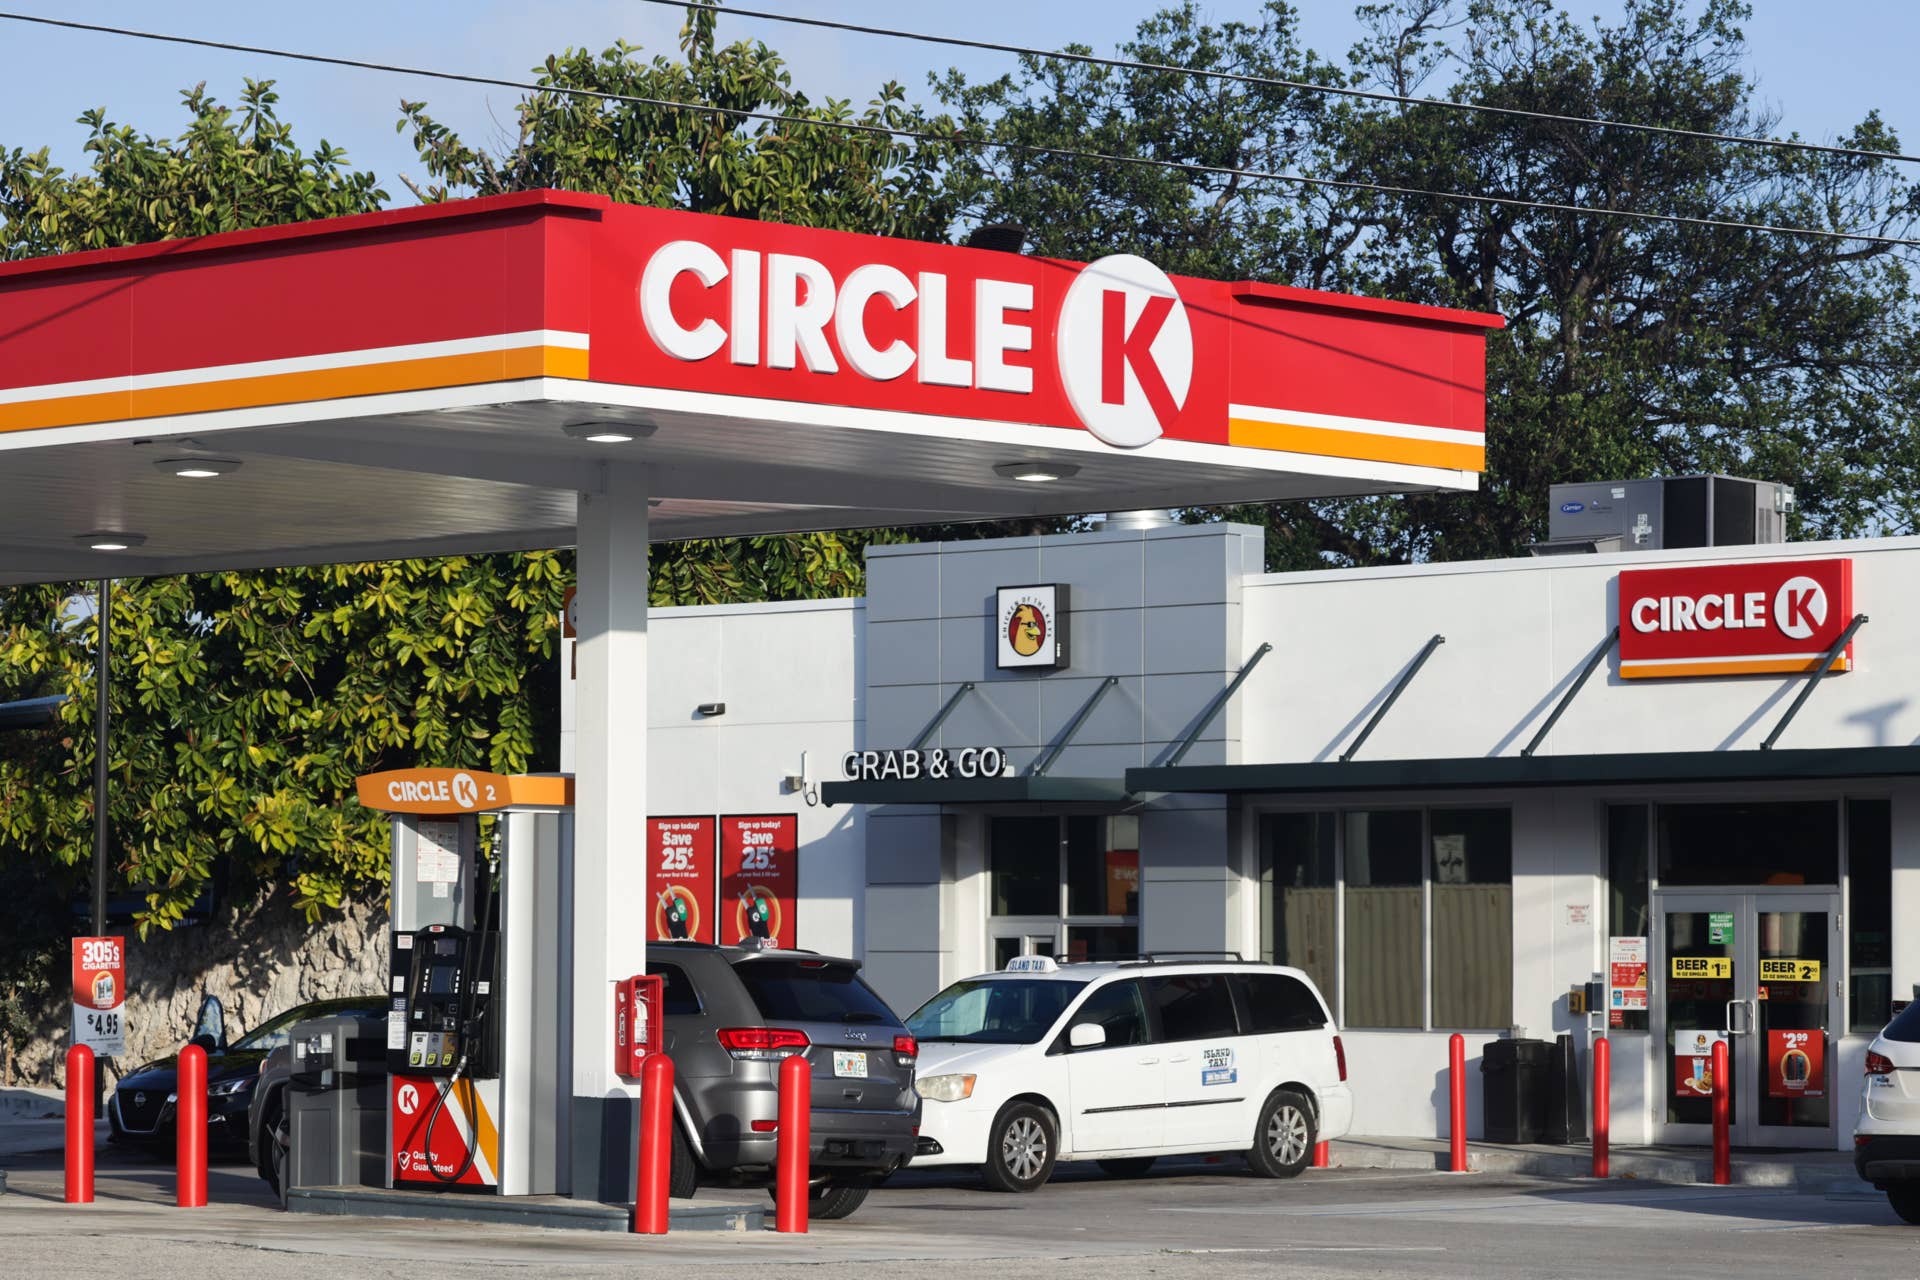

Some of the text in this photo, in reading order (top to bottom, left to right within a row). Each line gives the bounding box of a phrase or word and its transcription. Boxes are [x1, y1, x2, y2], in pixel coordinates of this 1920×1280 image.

[640, 240, 1034, 394] CIRCLE
[1631, 592, 1766, 633] CIRCLE
[842, 746, 1001, 781] GRAB & GO
[387, 780, 450, 802] CIRCLE
[485, 784, 497, 801] 2
[662, 831, 693, 846] Save
[742, 830, 774, 845] Save
[82, 941, 120, 963] 305's
[1009, 960, 1046, 971] ISLAND TAXI
[1676, 959, 1708, 970] BEER
[1763, 962, 1796, 973] BEER
[87, 1014, 119, 1036] $4.95
[1203, 1048, 1231, 1059] ISLAND
[1208, 1058, 1229, 1068] TAXI
